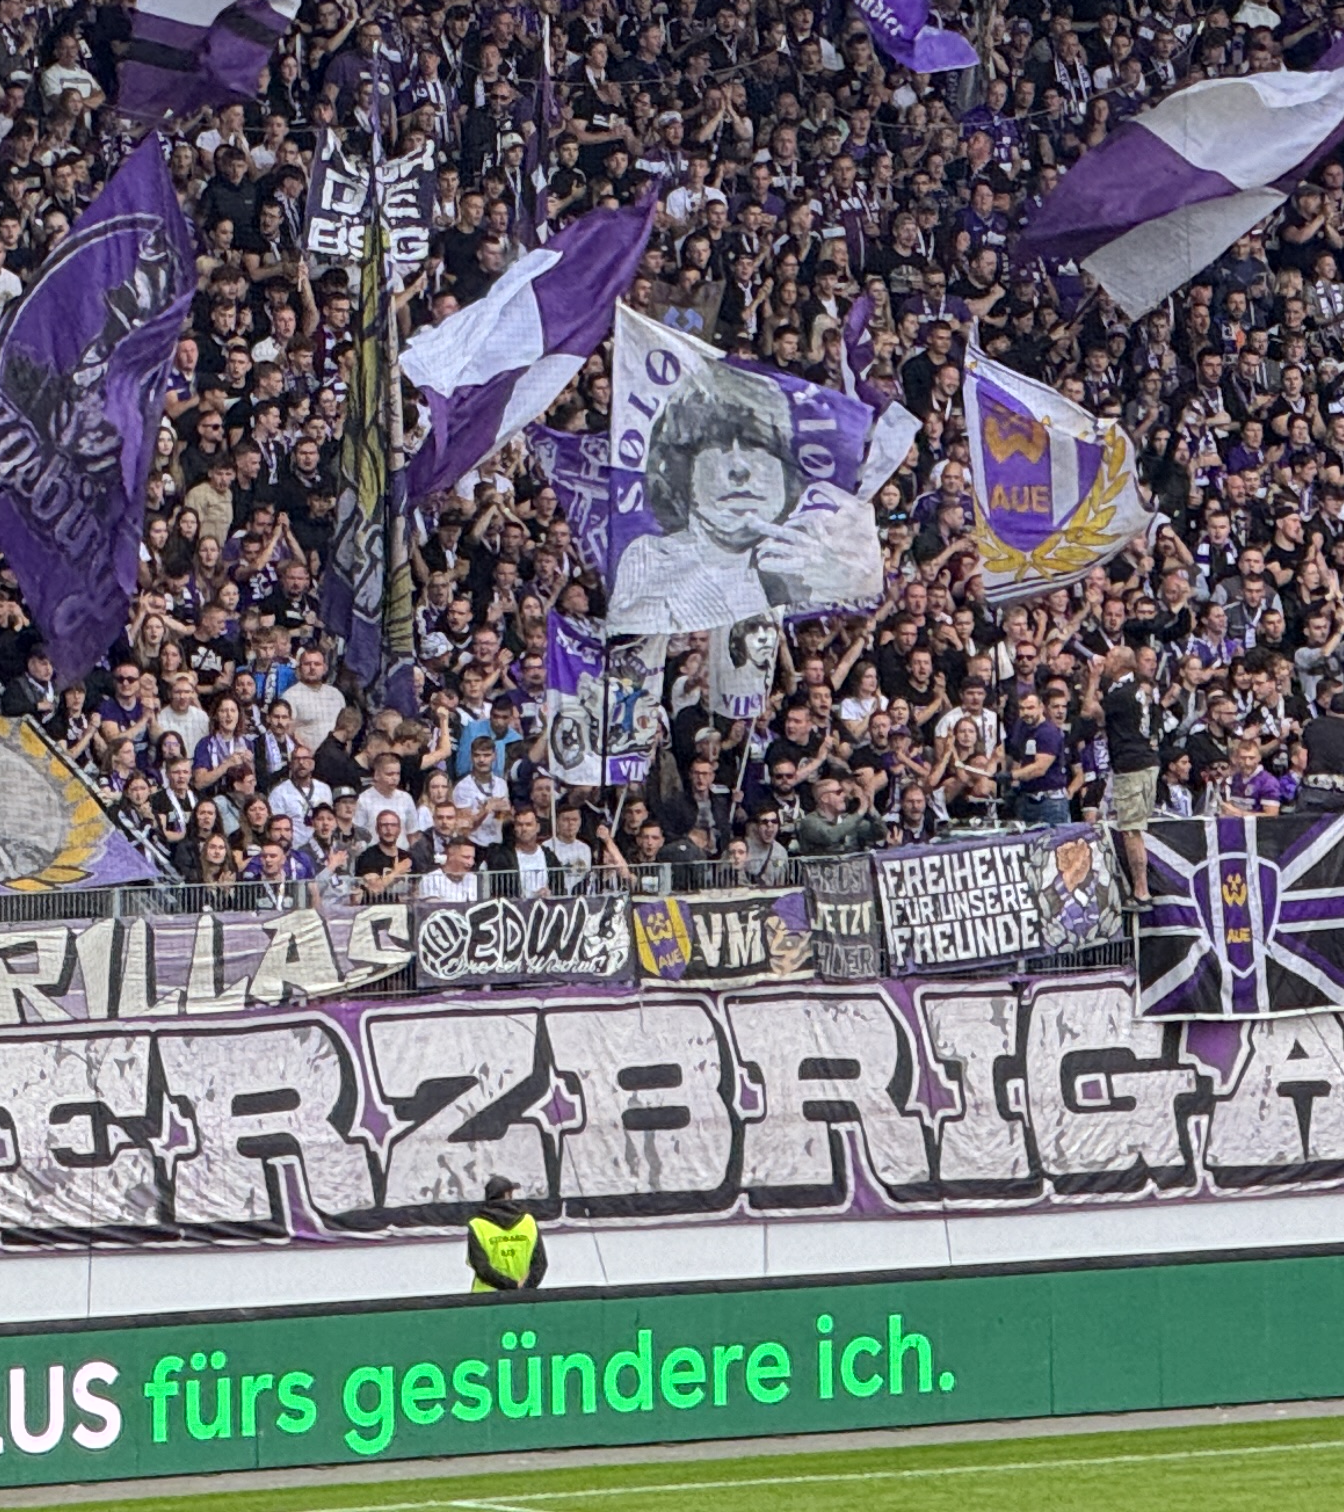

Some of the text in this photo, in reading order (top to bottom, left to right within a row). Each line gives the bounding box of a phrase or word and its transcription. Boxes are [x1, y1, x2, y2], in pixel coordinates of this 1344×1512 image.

[989, 485, 1051, 514] AUE
[882, 843, 1027, 897] FREIHEIT
[811, 900, 874, 937] JETZT
[937, 882, 1035, 923] UNSERE
[692, 910, 767, 969] VM
[892, 909, 1041, 967] FREUNDE
[143, 1350, 319, 1444] fürs
[342, 1328, 792, 1456] gesündere
[816, 1313, 956, 1400] ich.
